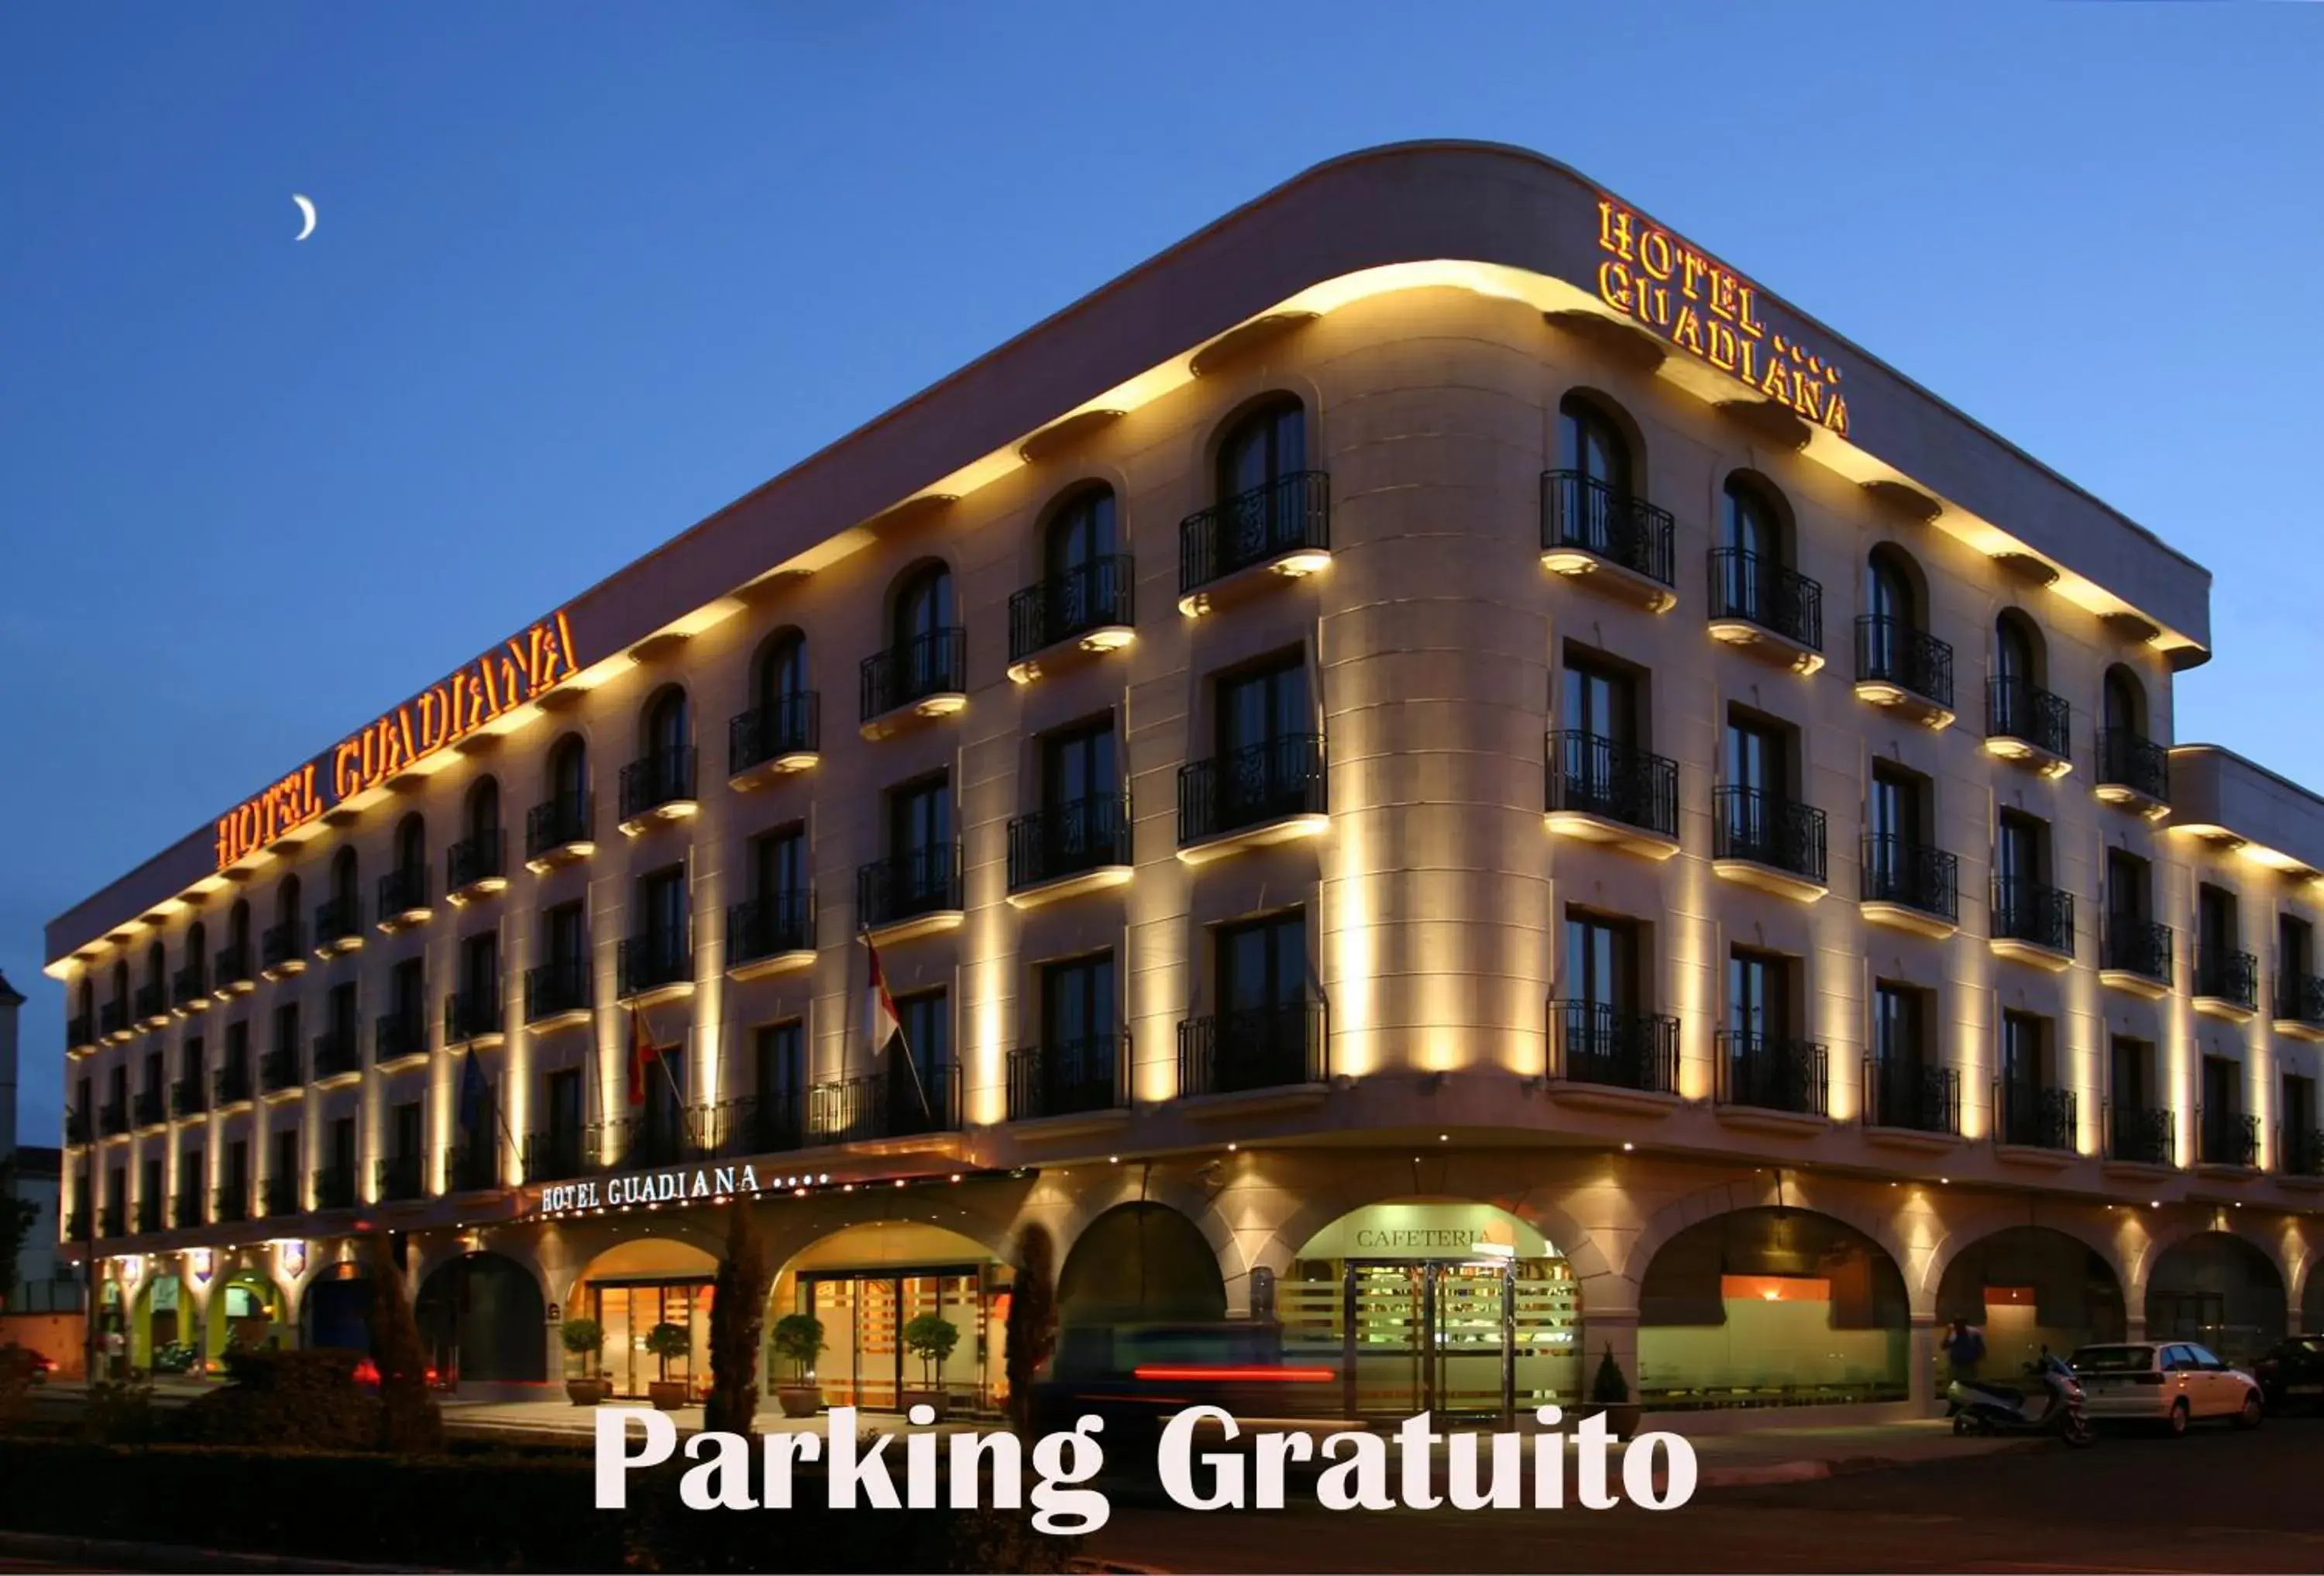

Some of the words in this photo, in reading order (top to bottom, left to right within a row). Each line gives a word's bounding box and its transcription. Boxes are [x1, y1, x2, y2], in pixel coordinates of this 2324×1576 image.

[1598, 200, 1763, 338] HOTEL
[1598, 261, 1850, 437] GUADIANA
[215, 762, 322, 869] HOTEL
[333, 609, 579, 803] GUADIANA
[541, 1182, 600, 1212] HOTEL
[608, 1165, 760, 1204] GUADIANA
[1356, 1229, 1493, 1248] CAFETERIA
